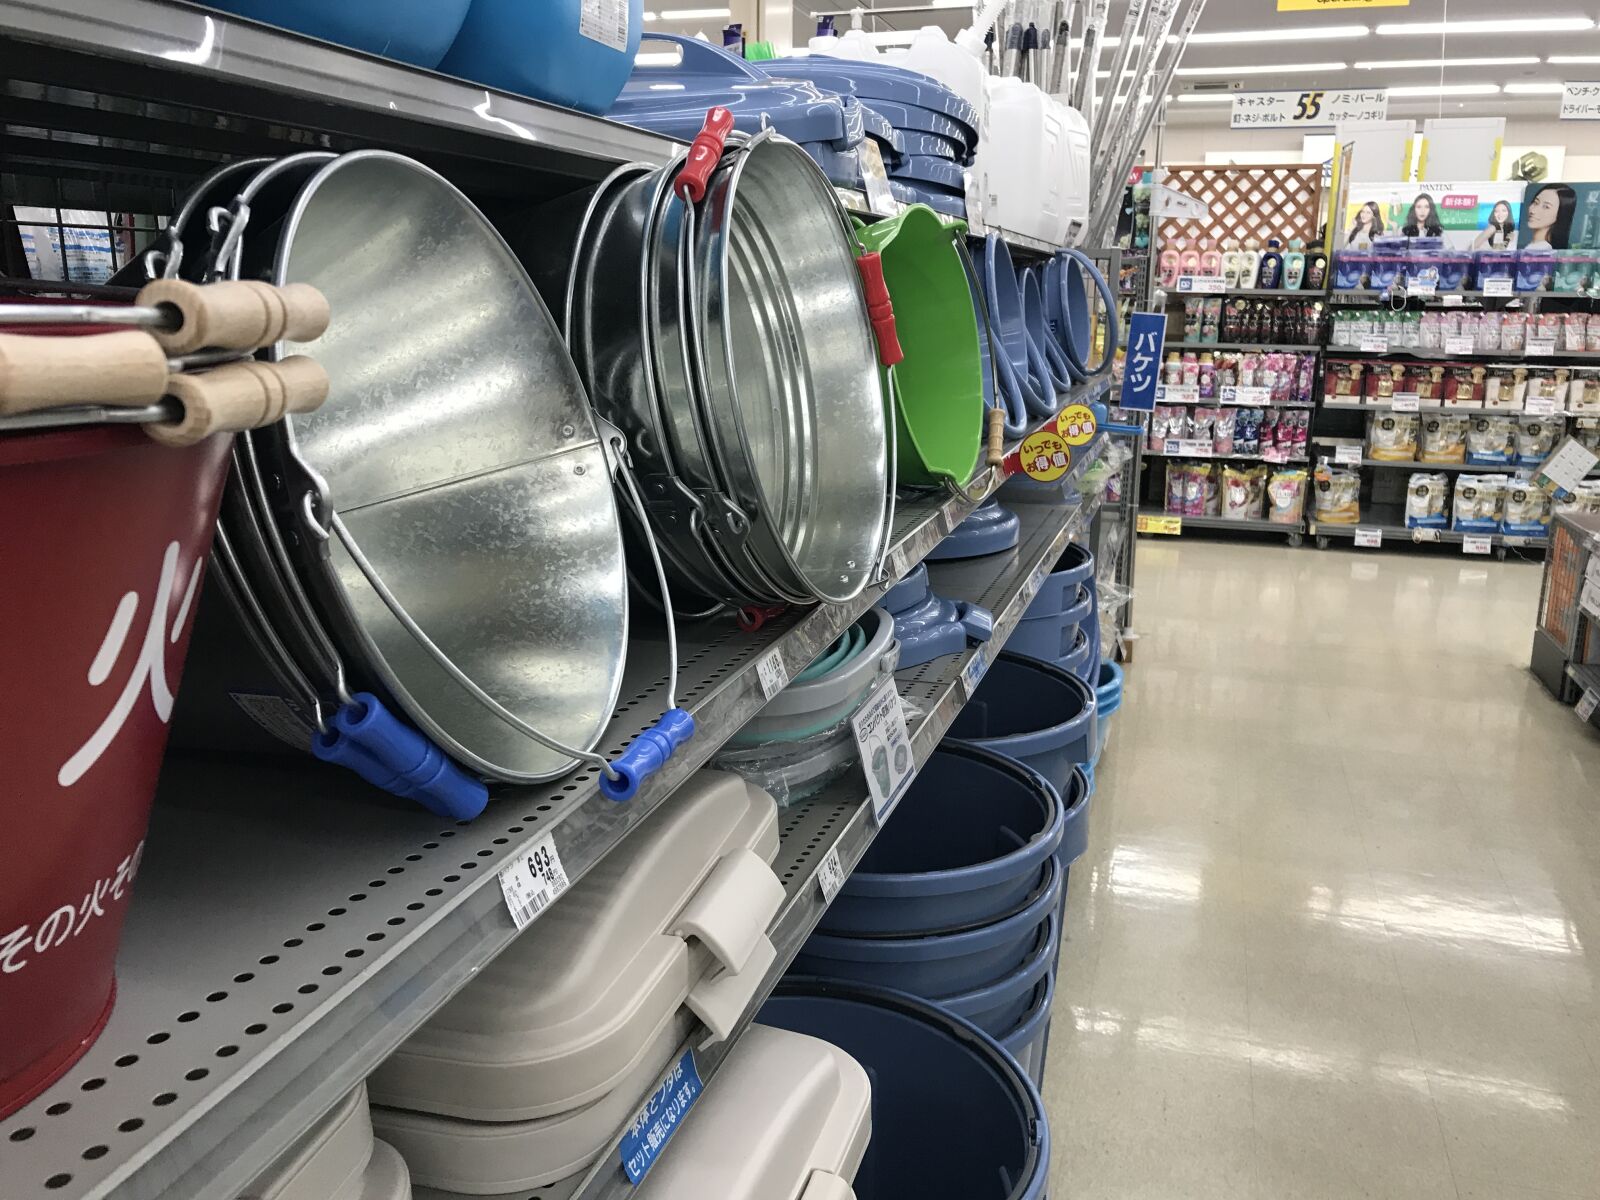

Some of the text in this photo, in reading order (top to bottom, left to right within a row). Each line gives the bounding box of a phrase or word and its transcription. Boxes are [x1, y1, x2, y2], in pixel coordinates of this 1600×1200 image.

[1237, 96, 1286, 107] キャスター
[1292, 92, 1324, 120] 55
[1419, 183, 1454, 192] PANTENE
[1130, 331, 1158, 393] バケツ
[1060, 411, 1091, 423] いつでも
[1023, 439, 1063, 454] いつでも
[527, 845, 551, 878] 693
[627, 1081, 697, 1178] セット販売になります。
